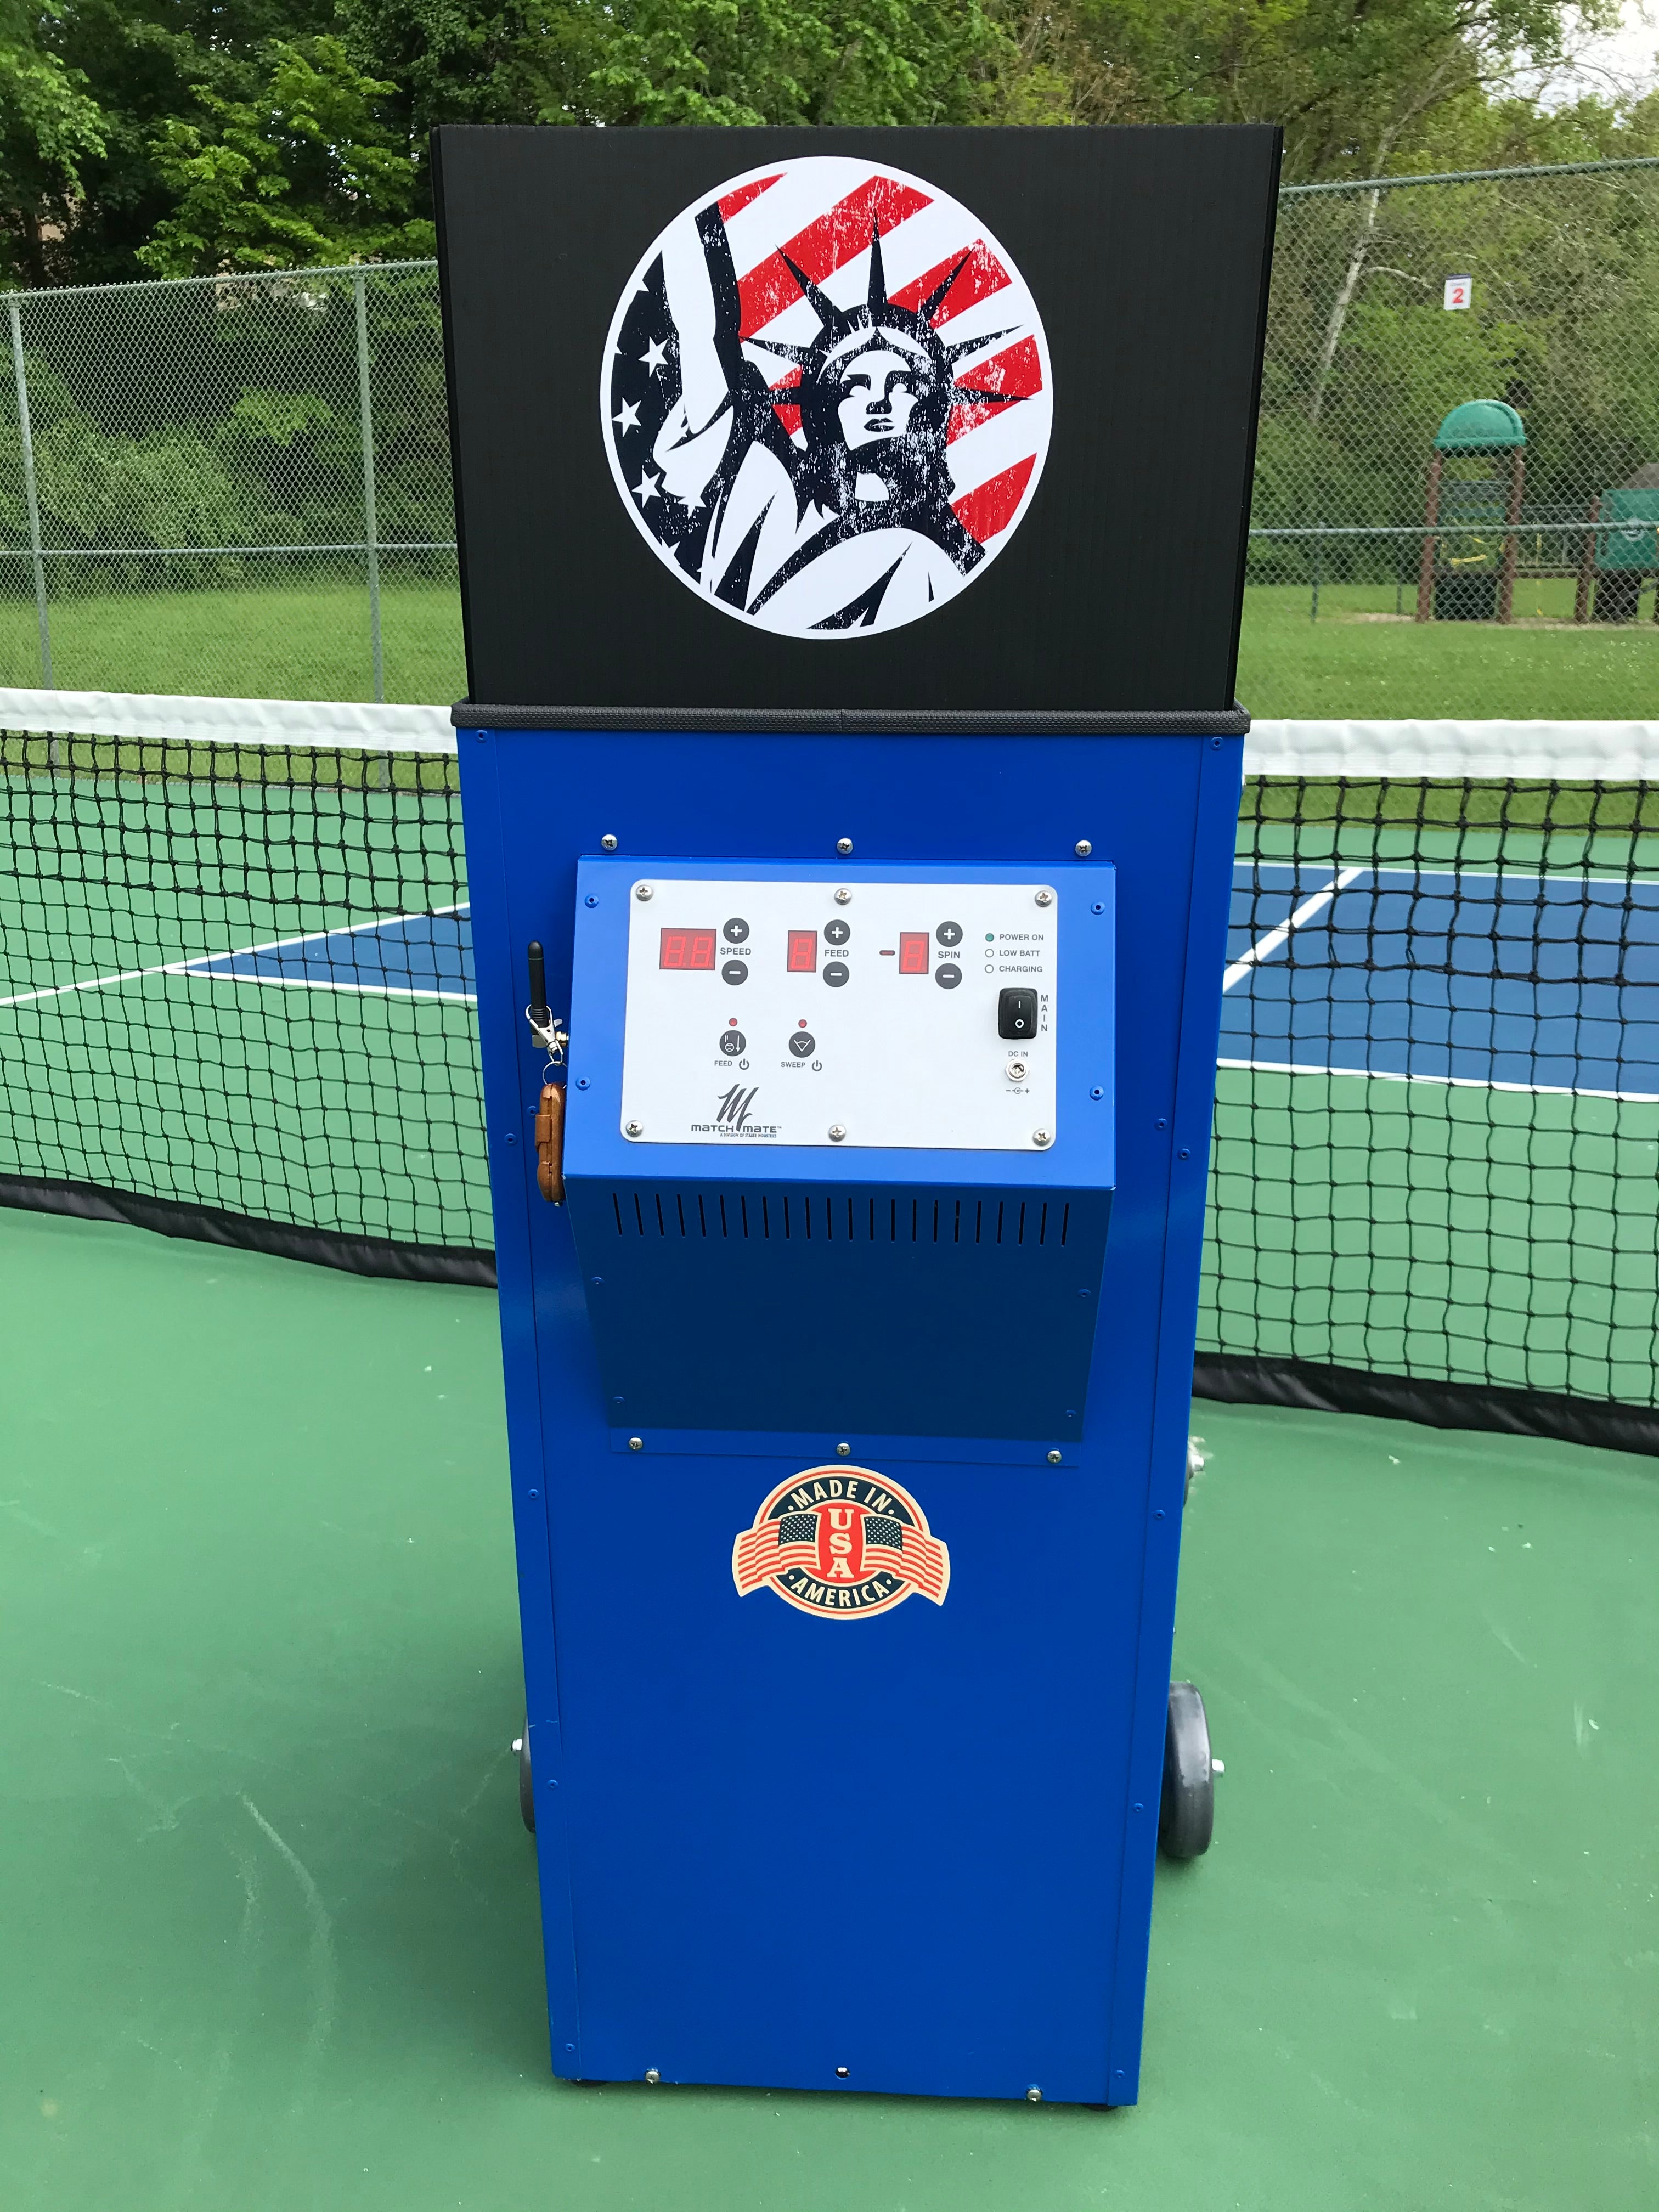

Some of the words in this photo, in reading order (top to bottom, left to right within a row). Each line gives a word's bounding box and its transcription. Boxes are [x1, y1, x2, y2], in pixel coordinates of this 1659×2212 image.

[1452, 288, 1464, 304] 2
[720, 947, 751, 956] SPEED
[938, 951, 960, 959] SPIN
[791, 1479, 857, 1510] MADE
[864, 1487, 893, 1513] IN
[826, 1509, 854, 1578] USA
[791, 1577, 890, 1606] AMERICA
